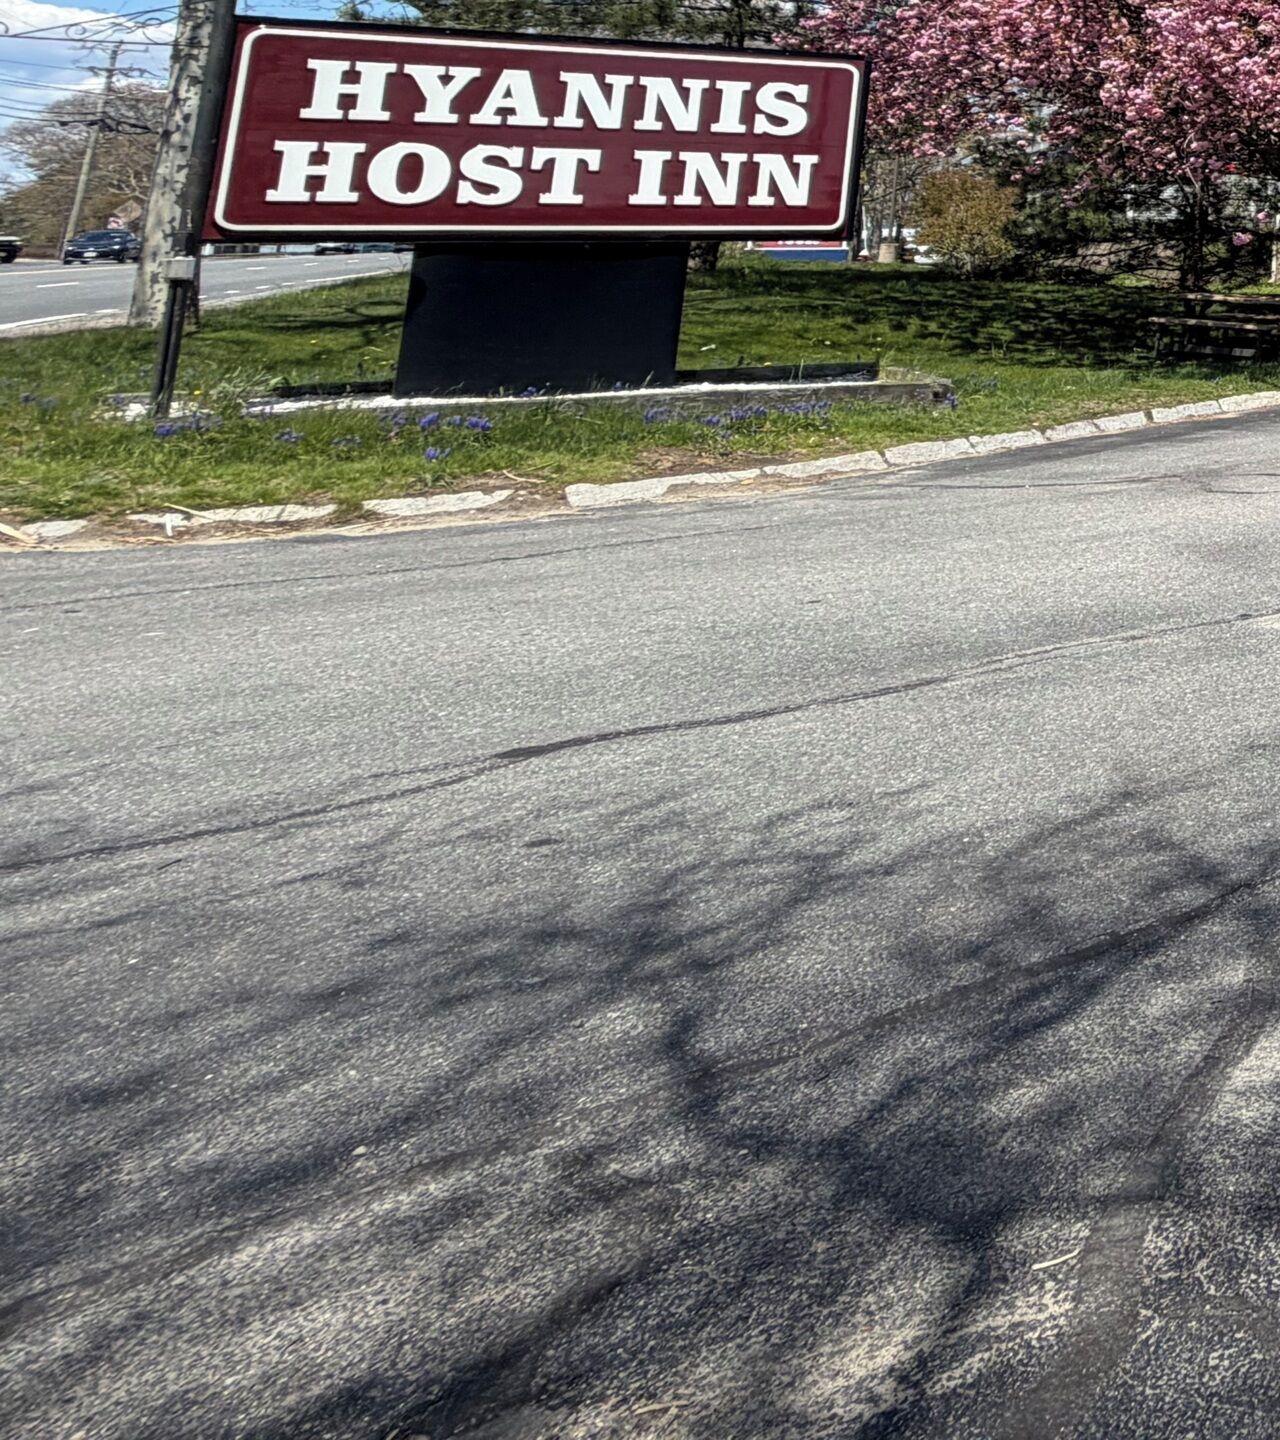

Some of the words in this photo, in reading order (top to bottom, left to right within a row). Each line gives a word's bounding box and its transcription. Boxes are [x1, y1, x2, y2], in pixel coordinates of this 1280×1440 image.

[299, 57, 810, 137] HYANNIS
[265, 139, 602, 206] HOST
[628, 149, 819, 207] INN
